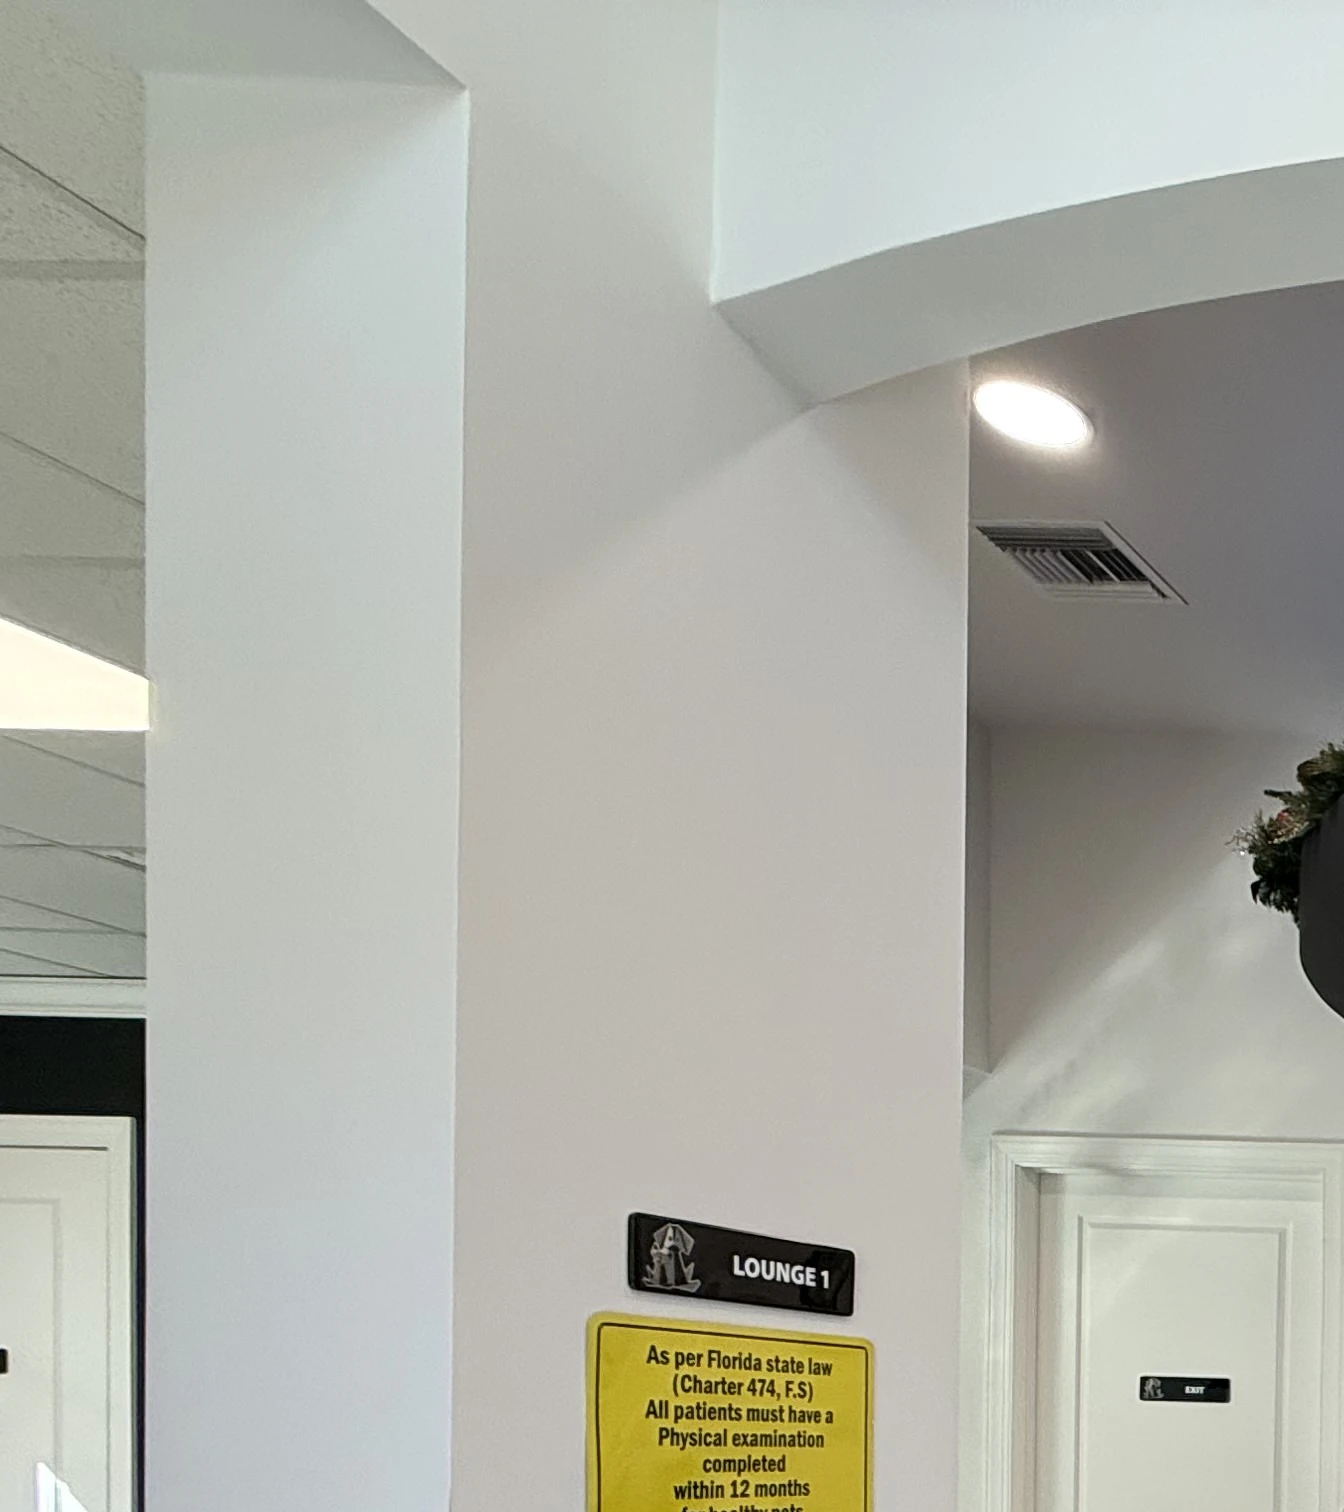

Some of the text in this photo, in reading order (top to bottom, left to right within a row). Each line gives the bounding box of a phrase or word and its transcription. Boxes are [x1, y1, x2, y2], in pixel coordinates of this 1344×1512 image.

[733, 1254, 829, 1289] LOUNGE 1
[646, 1345, 833, 1376] As per Florida state law
[672, 1374, 814, 1403] (Charter 474, F.S)
[645, 1399, 833, 1424] All patients must have a
[658, 1426, 824, 1450] Physical examination
[702, 1454, 786, 1477] completed
[674, 1479, 810, 1500] within 12 months
